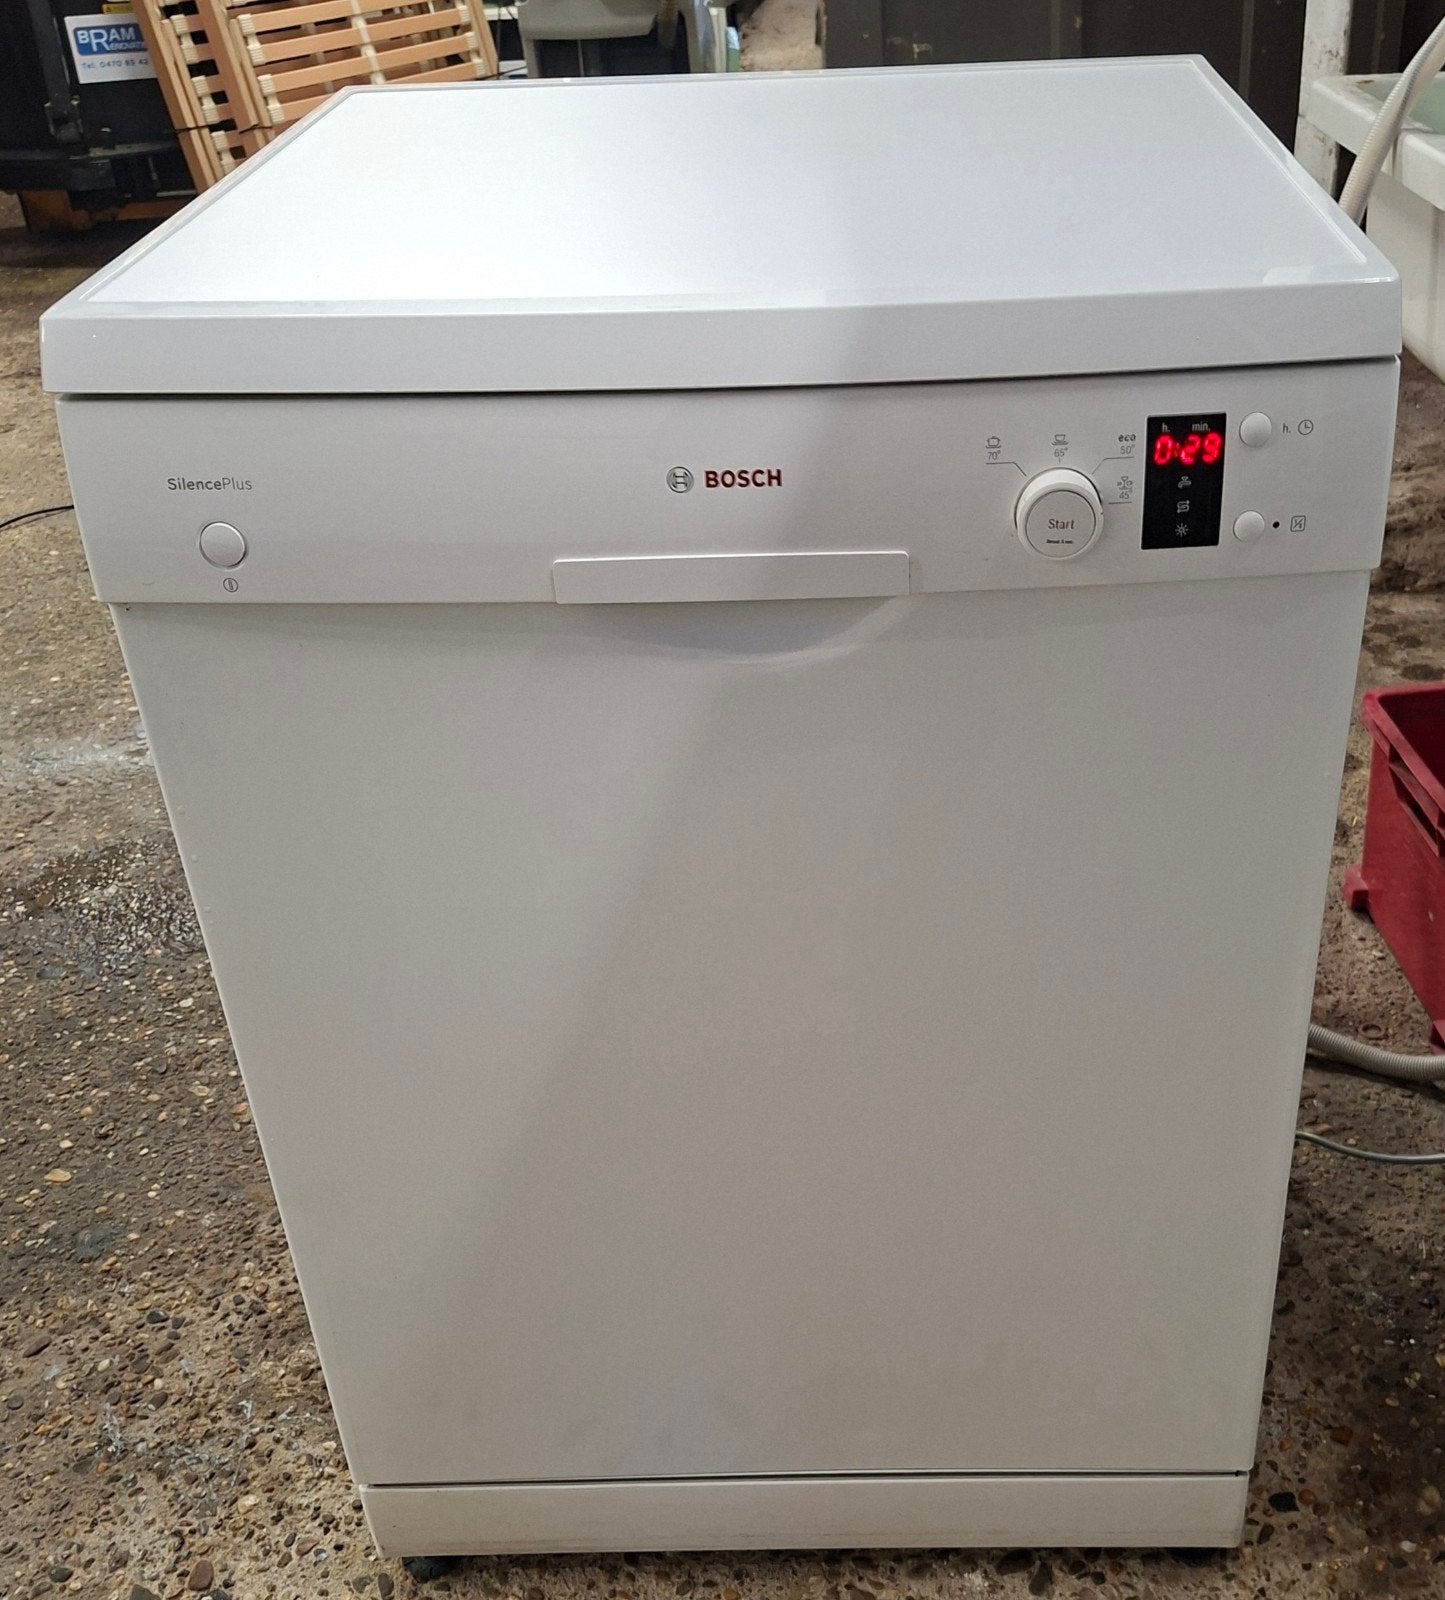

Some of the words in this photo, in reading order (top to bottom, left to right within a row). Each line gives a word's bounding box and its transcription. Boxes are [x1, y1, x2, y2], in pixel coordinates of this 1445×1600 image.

[77, 27, 136, 52] BRAM
[1191, 421, 1211, 432] min.
[1117, 433, 1137, 443] eco
[1154, 432, 1223, 466] 0:29
[166, 477, 253, 491] SilencePlus
[704, 468, 783, 489] BOSCH
[1047, 518, 1075, 530] Start
